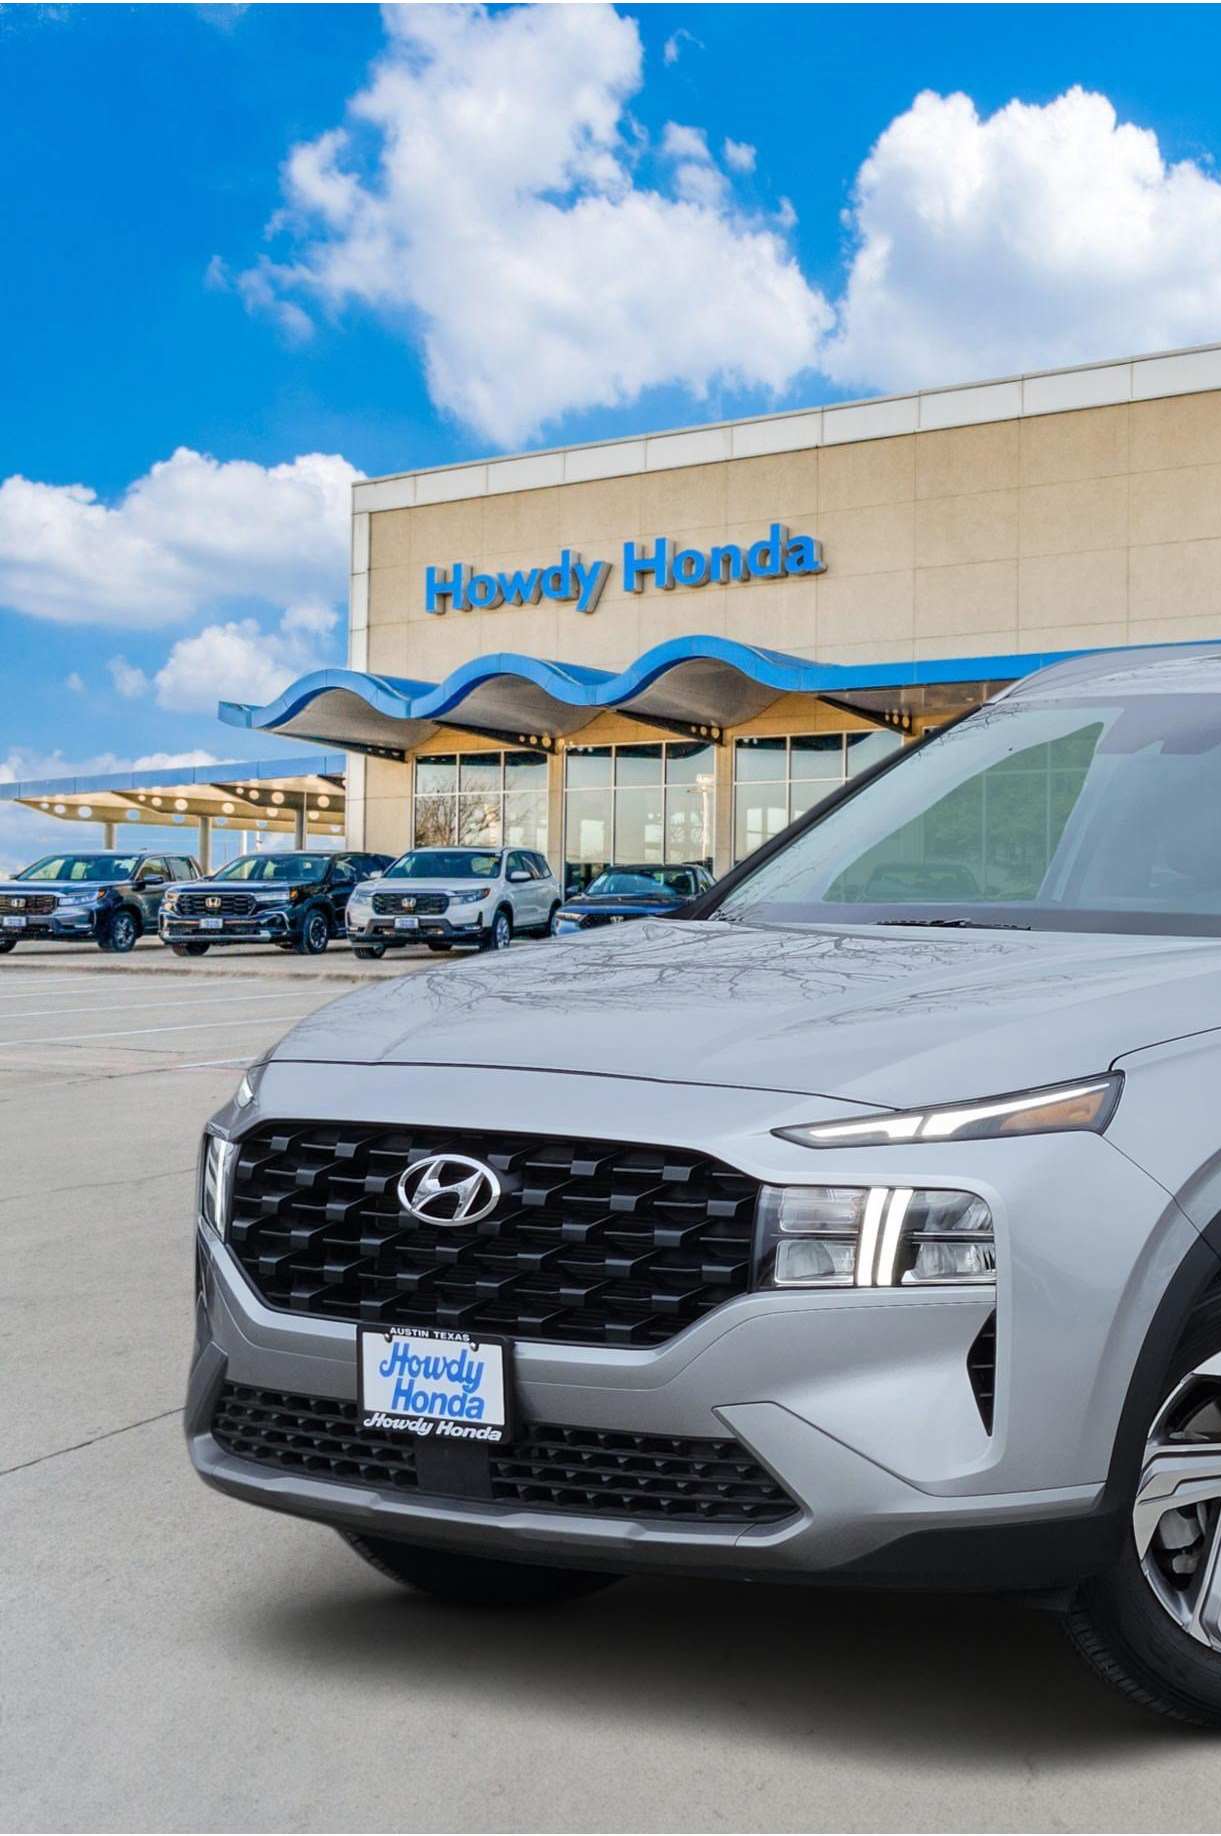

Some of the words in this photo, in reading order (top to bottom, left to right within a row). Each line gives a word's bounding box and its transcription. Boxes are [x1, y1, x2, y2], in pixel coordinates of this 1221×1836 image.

[425, 548, 612, 614] Howdy
[623, 523, 827, 594] Honda
[390, 1327, 430, 1338] AUSTIN
[433, 1330, 471, 1342] TEXAS
[379, 1342, 485, 1393] Howdy
[391, 1378, 485, 1419] Honda
[363, 1412, 434, 1436] Howdy
[436, 1420, 502, 1442] Honda
